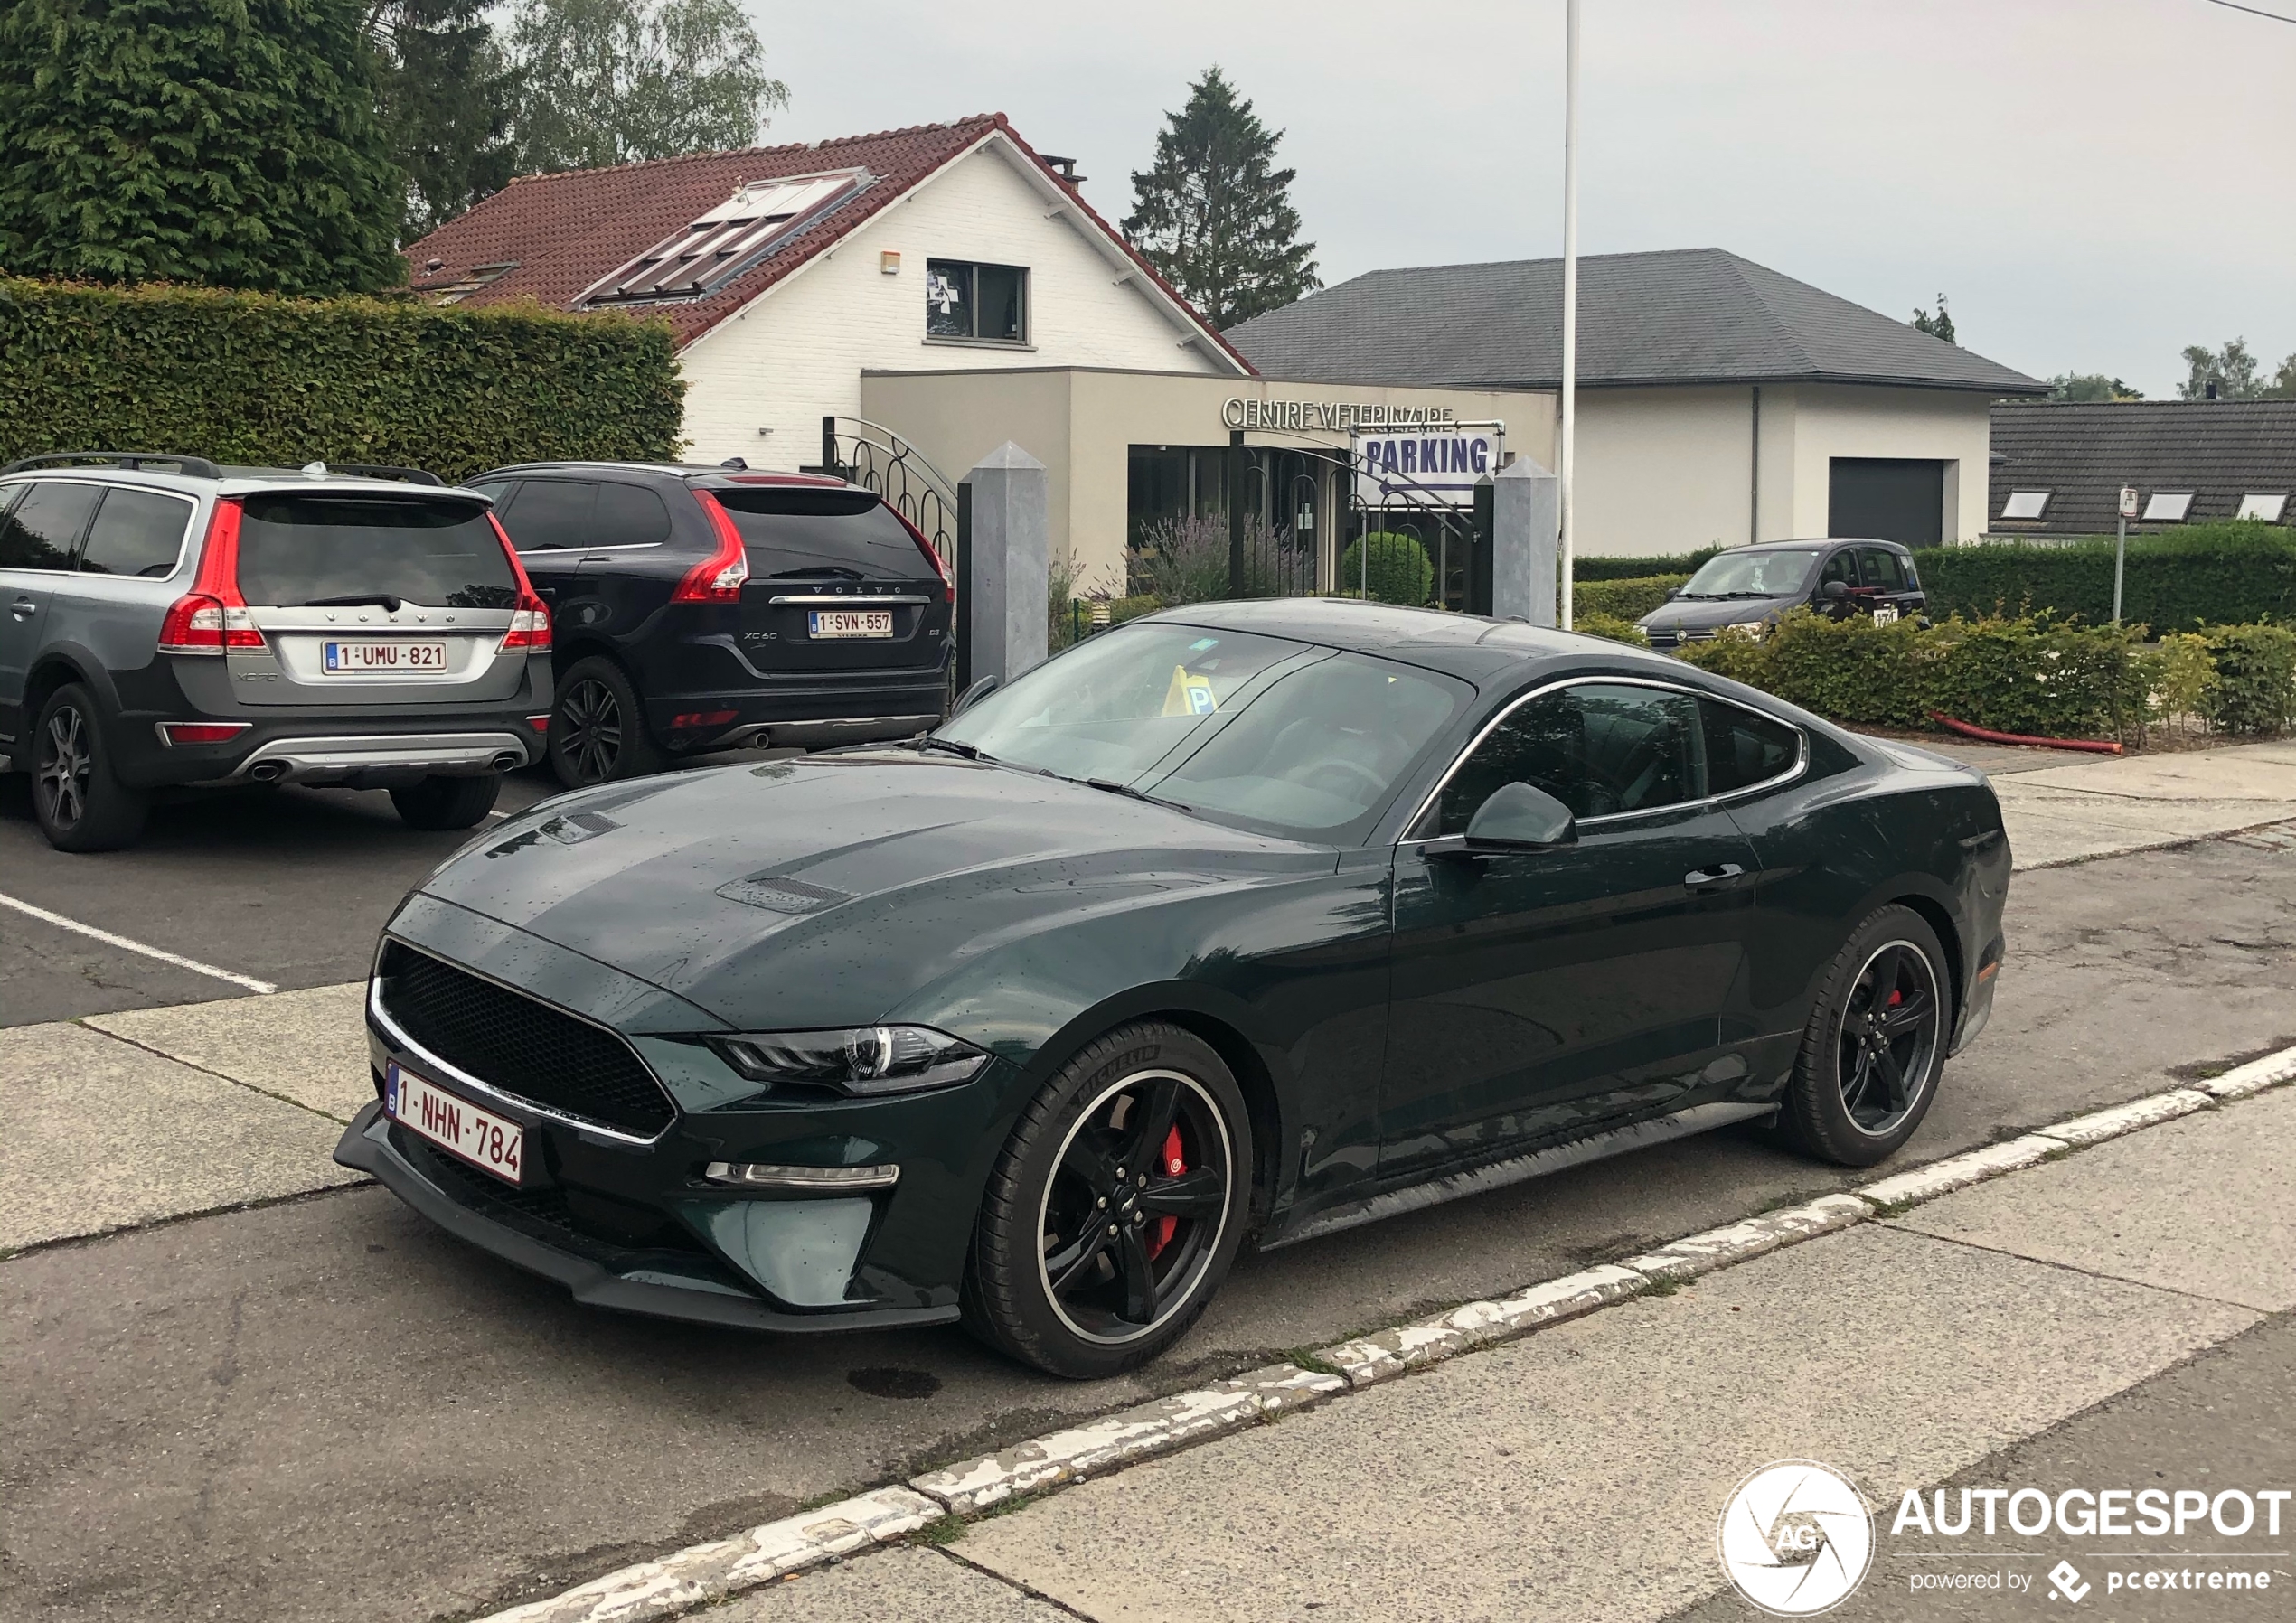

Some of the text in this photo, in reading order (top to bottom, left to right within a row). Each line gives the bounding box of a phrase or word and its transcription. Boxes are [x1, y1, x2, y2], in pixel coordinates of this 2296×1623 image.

[1222, 397, 1454, 433] CENTRE VETERINAIRE
[1366, 438, 1488, 474] PARKING
[325, 614, 456, 623] VOLVO
[820, 614, 889, 631] 1-SVN-557
[744, 632, 778, 640] XC60
[341, 646, 441, 666] 1-UMU-821
[388, 1080, 520, 1172] B 1-NHN-784
